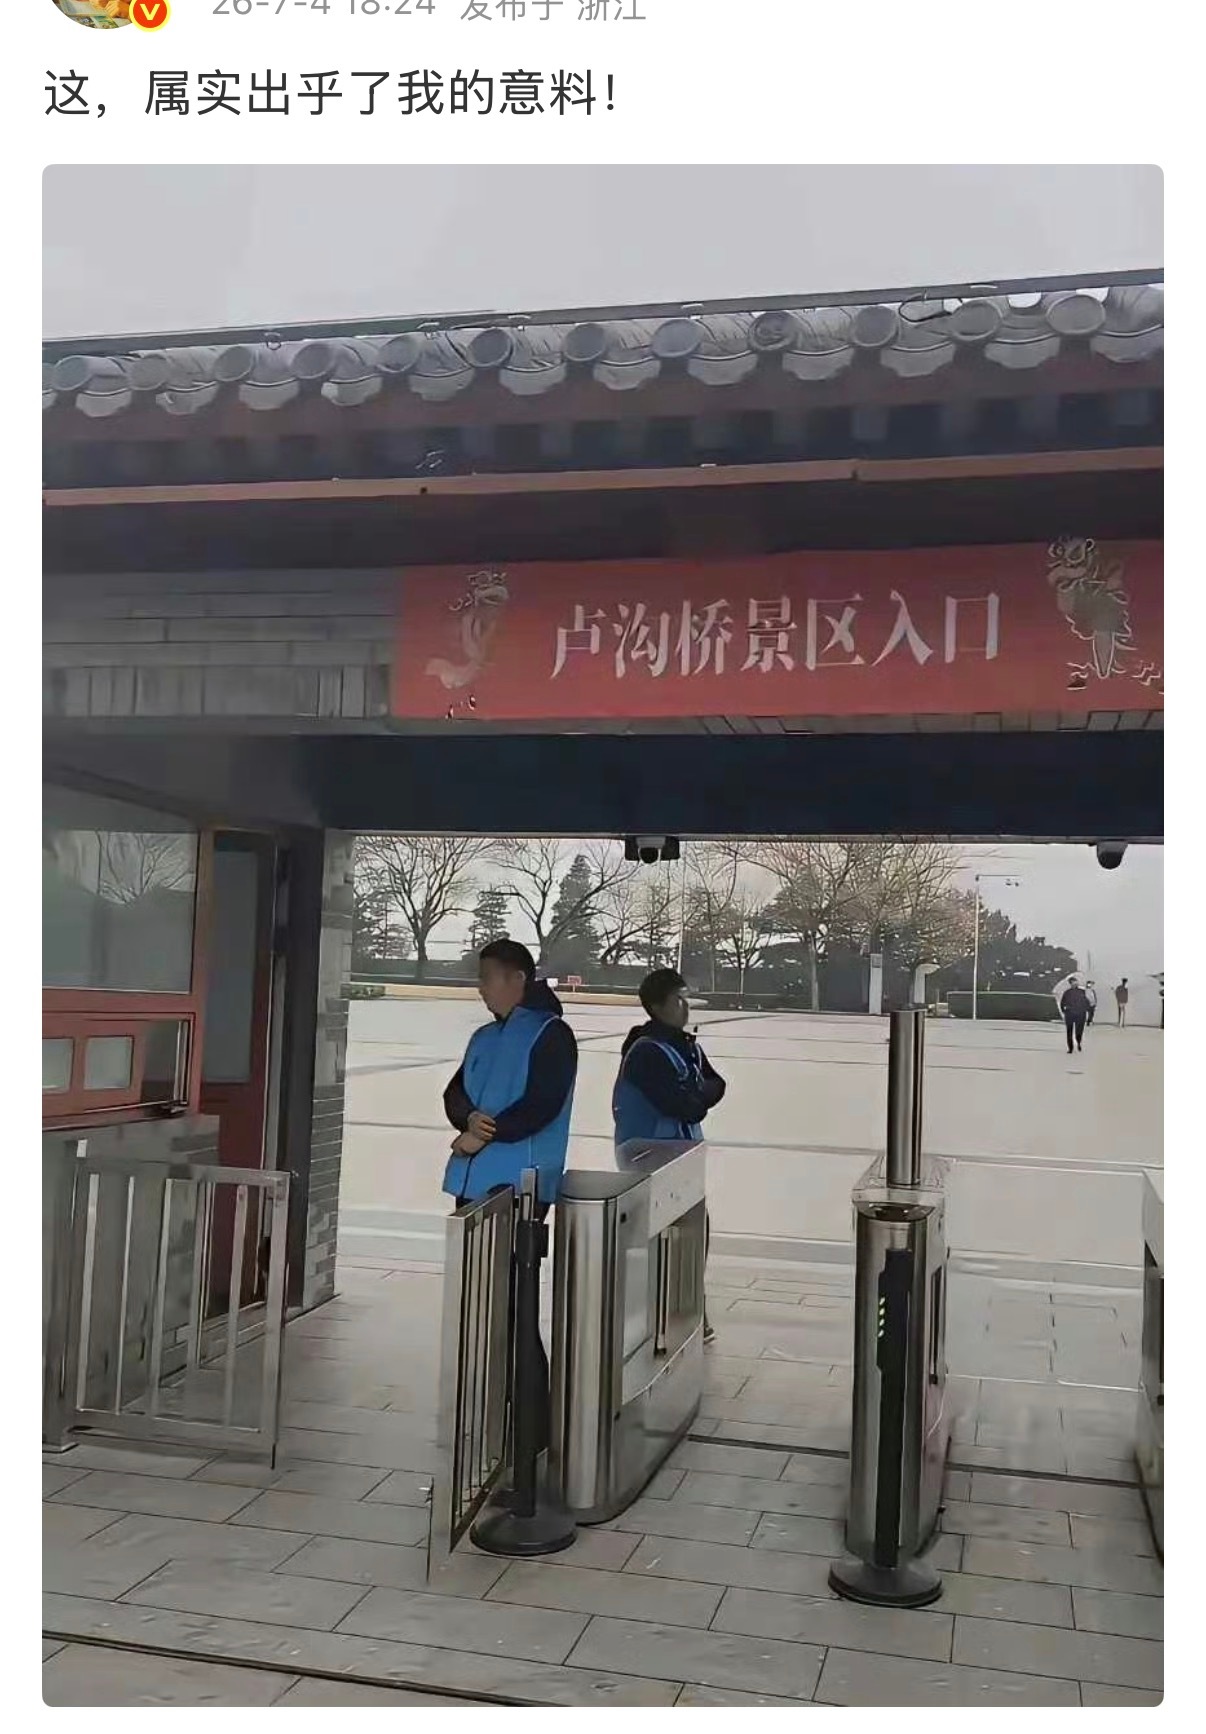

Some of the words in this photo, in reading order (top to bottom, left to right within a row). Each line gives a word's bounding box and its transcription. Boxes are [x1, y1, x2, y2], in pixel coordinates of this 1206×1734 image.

[549, 589, 1000, 680] 卢沟桥景区入口
